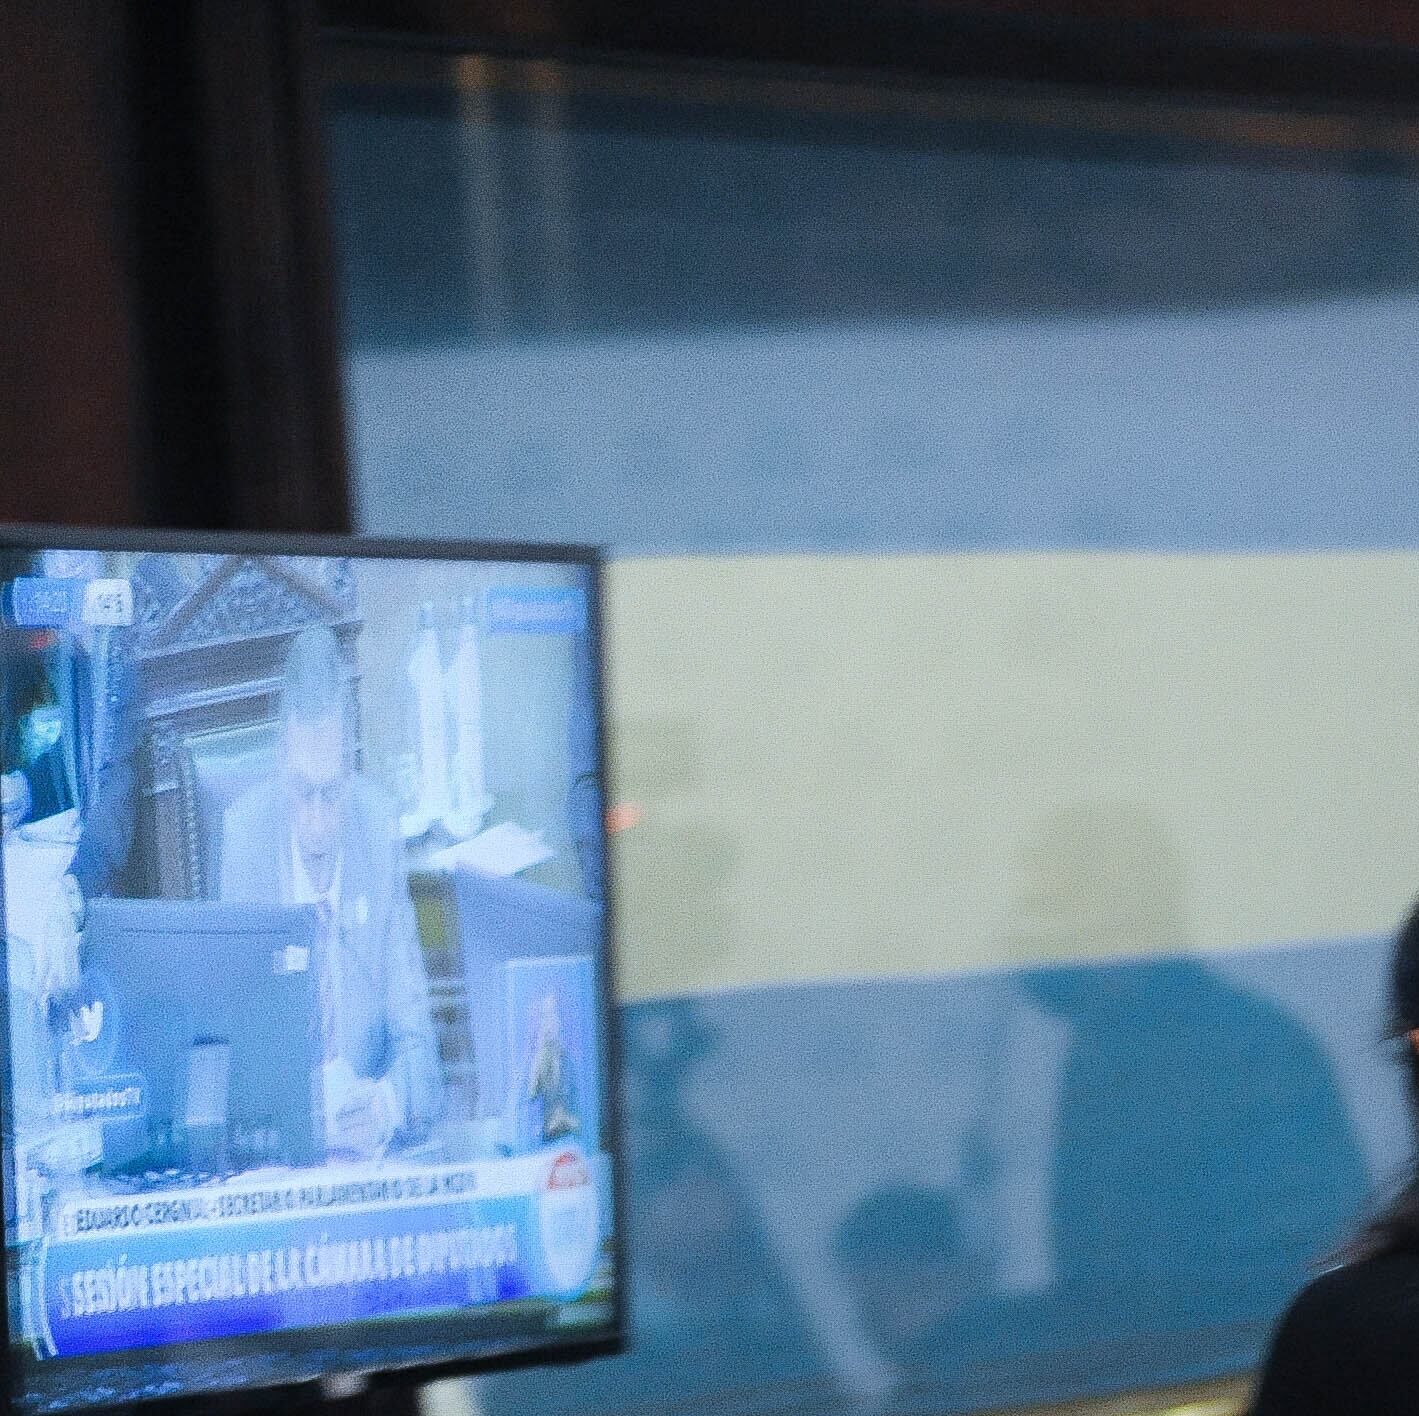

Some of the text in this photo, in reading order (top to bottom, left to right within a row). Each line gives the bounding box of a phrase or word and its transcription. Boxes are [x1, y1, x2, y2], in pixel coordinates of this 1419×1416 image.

[72, 1253, 148, 1316] SESIÓN
[152, 1253, 244, 1307] ESPECIAL
[248, 1249, 274, 1296] DE
[276, 1248, 302, 1290] LA
[390, 1236, 415, 1278] DE
